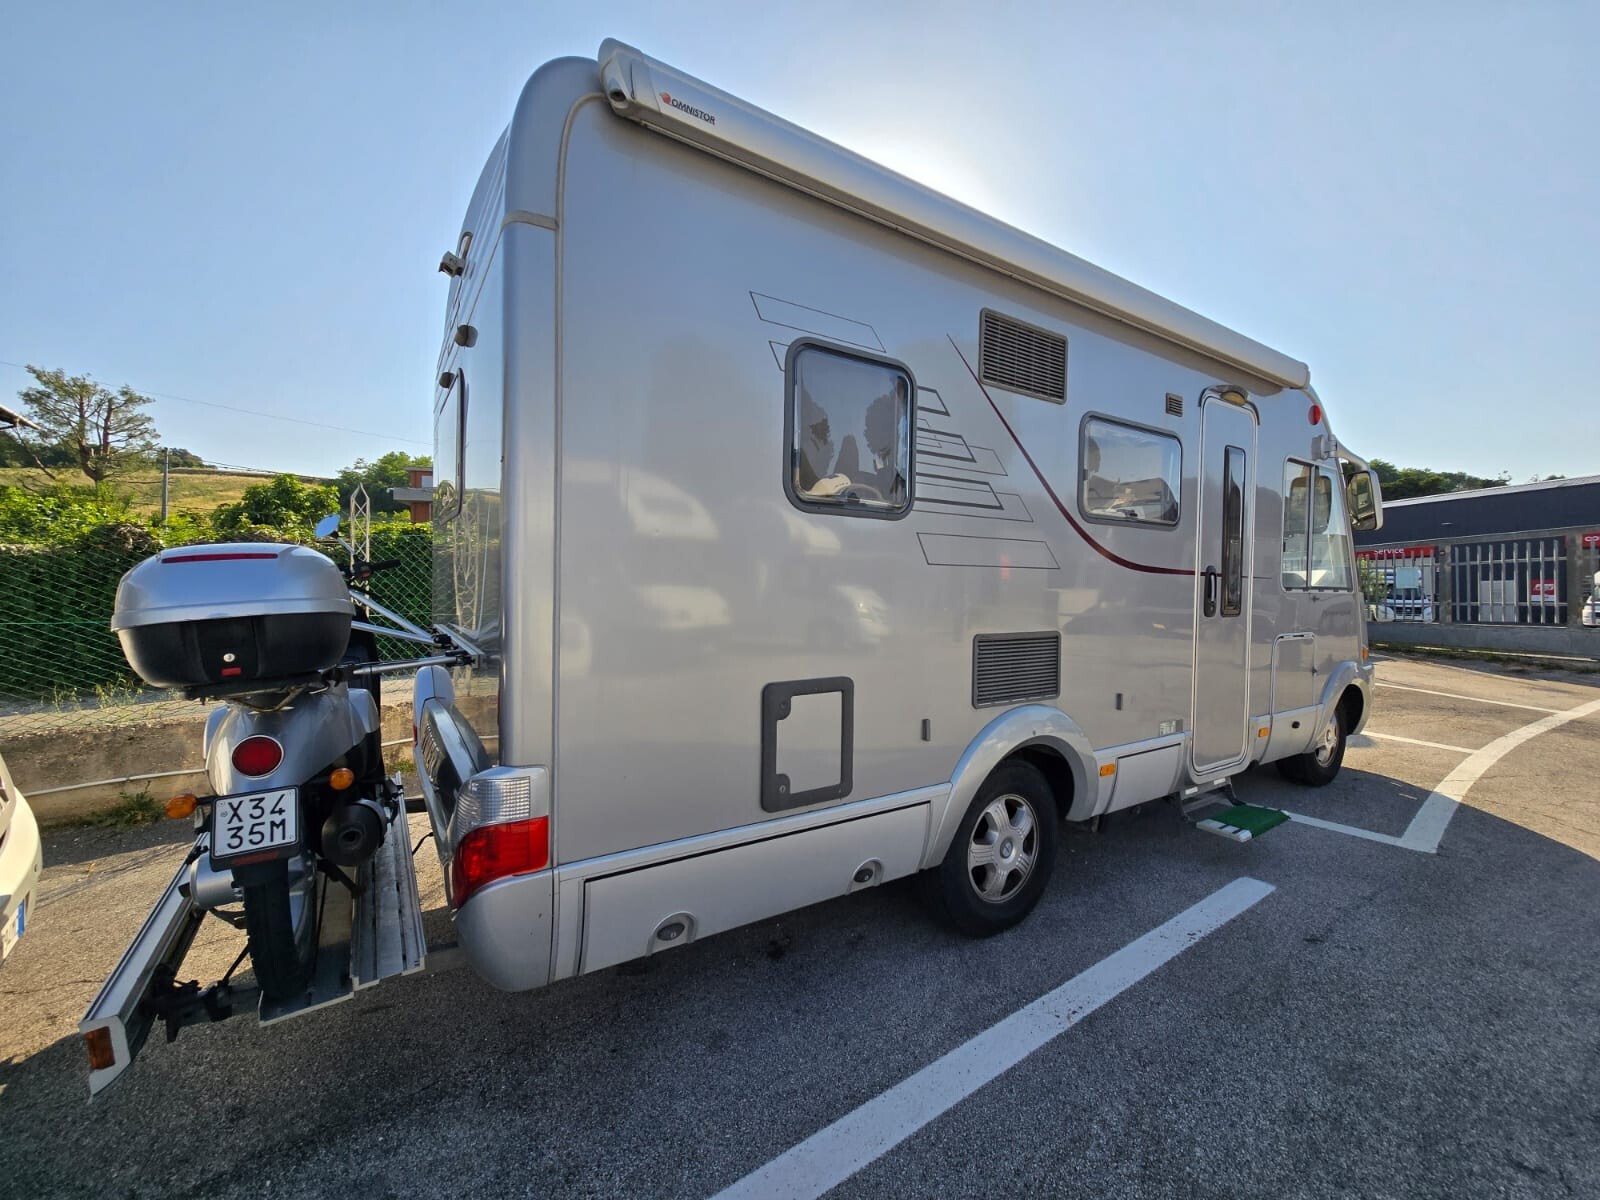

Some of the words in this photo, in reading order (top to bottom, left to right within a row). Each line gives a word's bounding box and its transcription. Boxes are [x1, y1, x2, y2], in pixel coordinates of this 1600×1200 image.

[671, 98, 715, 125] OMNISTOR
[227, 793, 286, 824] X34
[226, 818, 286, 849] 35M
